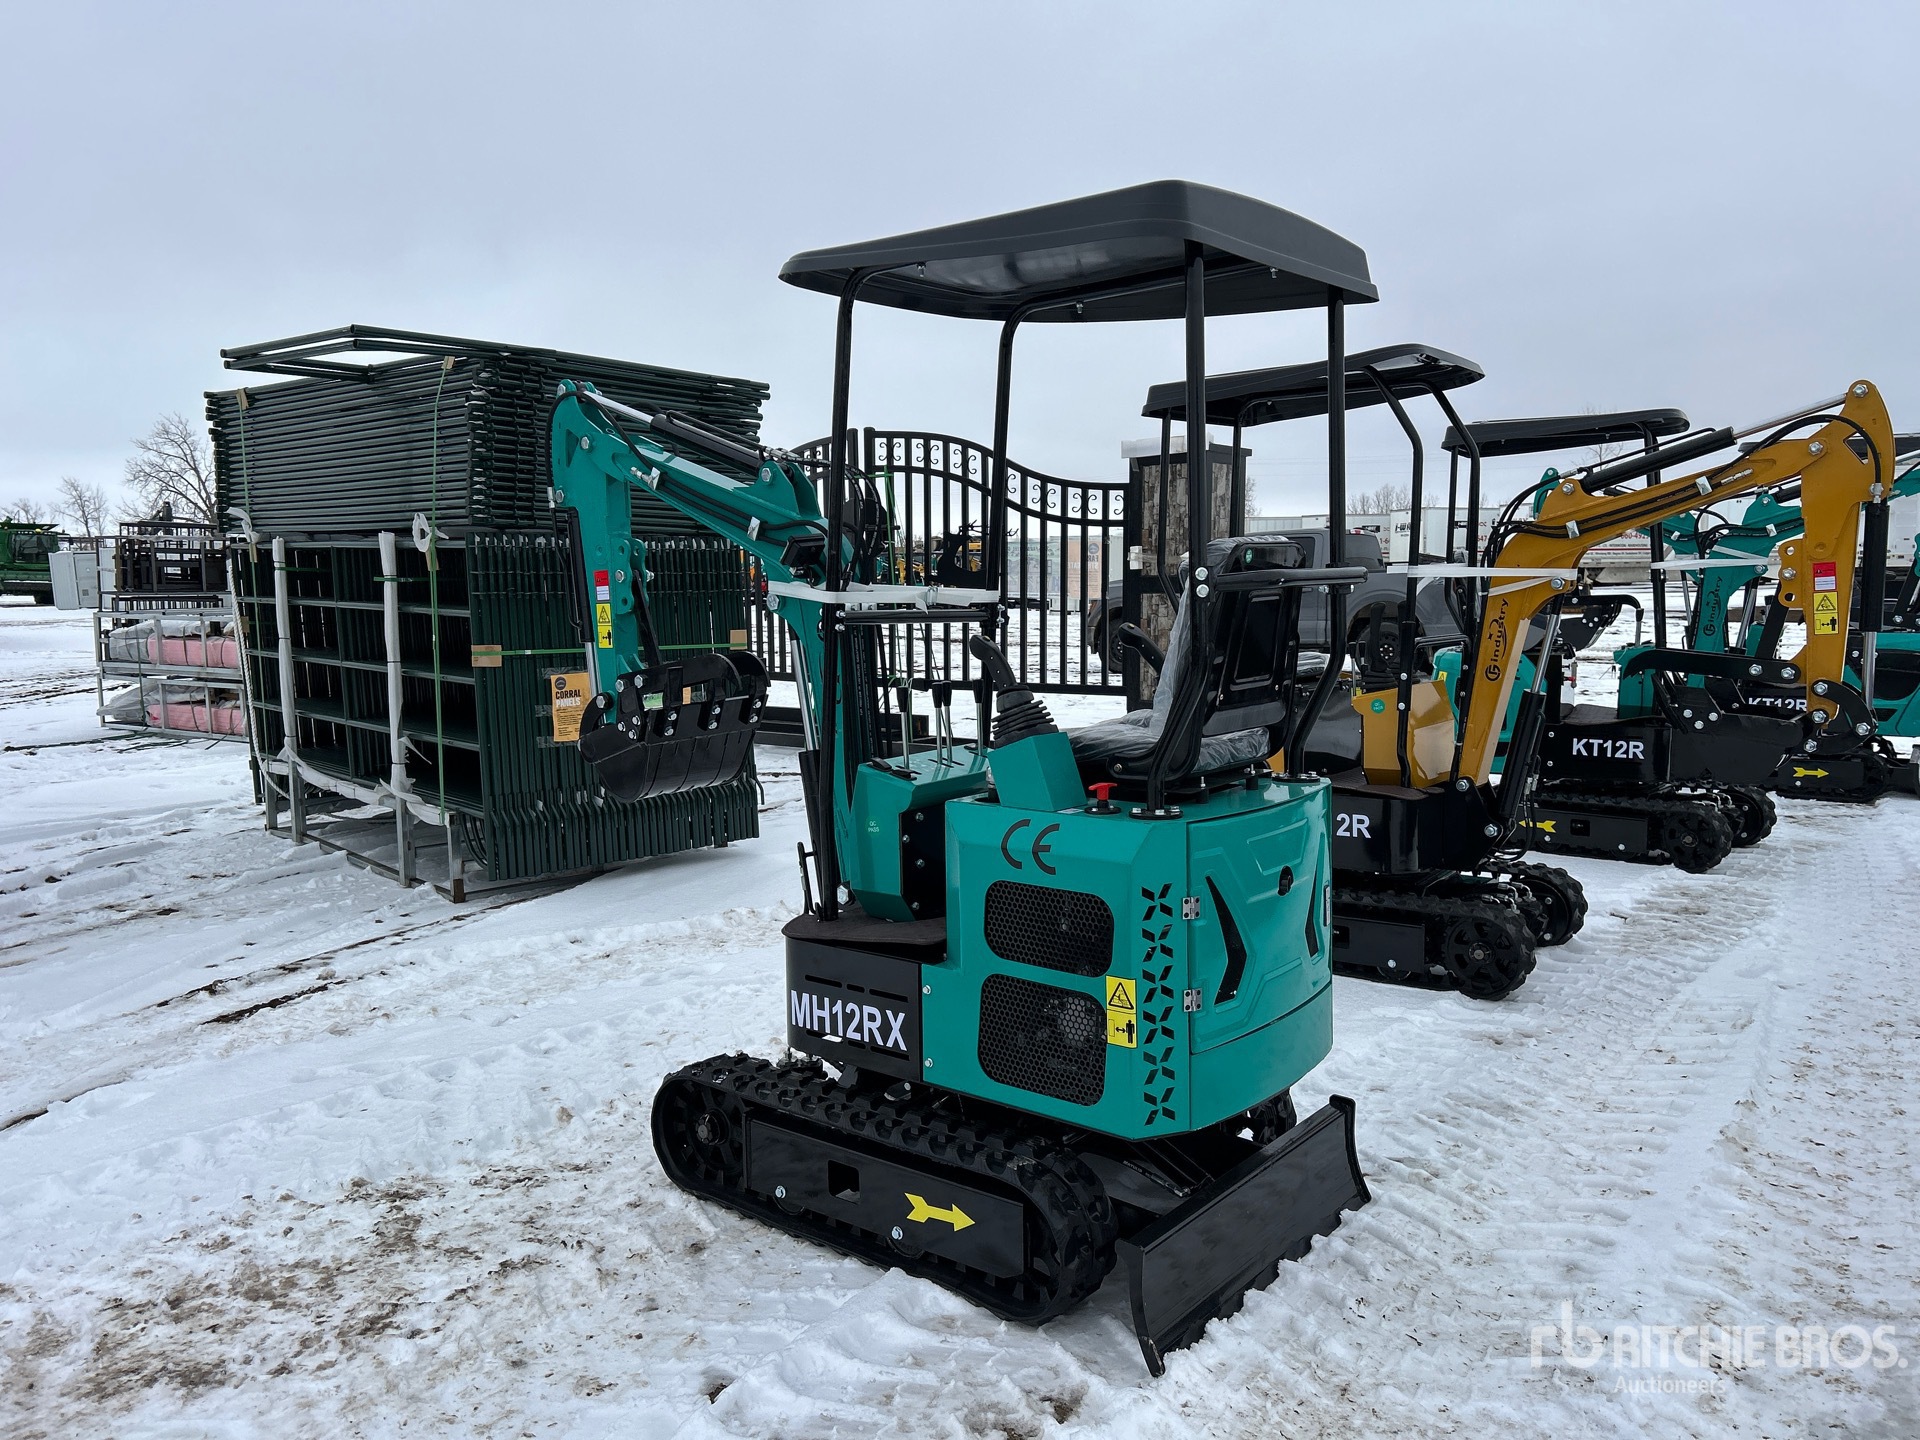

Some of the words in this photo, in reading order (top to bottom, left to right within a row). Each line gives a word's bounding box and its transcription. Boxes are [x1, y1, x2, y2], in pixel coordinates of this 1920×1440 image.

[555, 689, 582, 700] CORRAL
[556, 697, 581, 707] PANELS
[1572, 738, 1645, 760] KT12R
[1336, 813, 1372, 839] 2R
[1001, 818, 1060, 876] CE
[790, 989, 908, 1052] MH12RX
